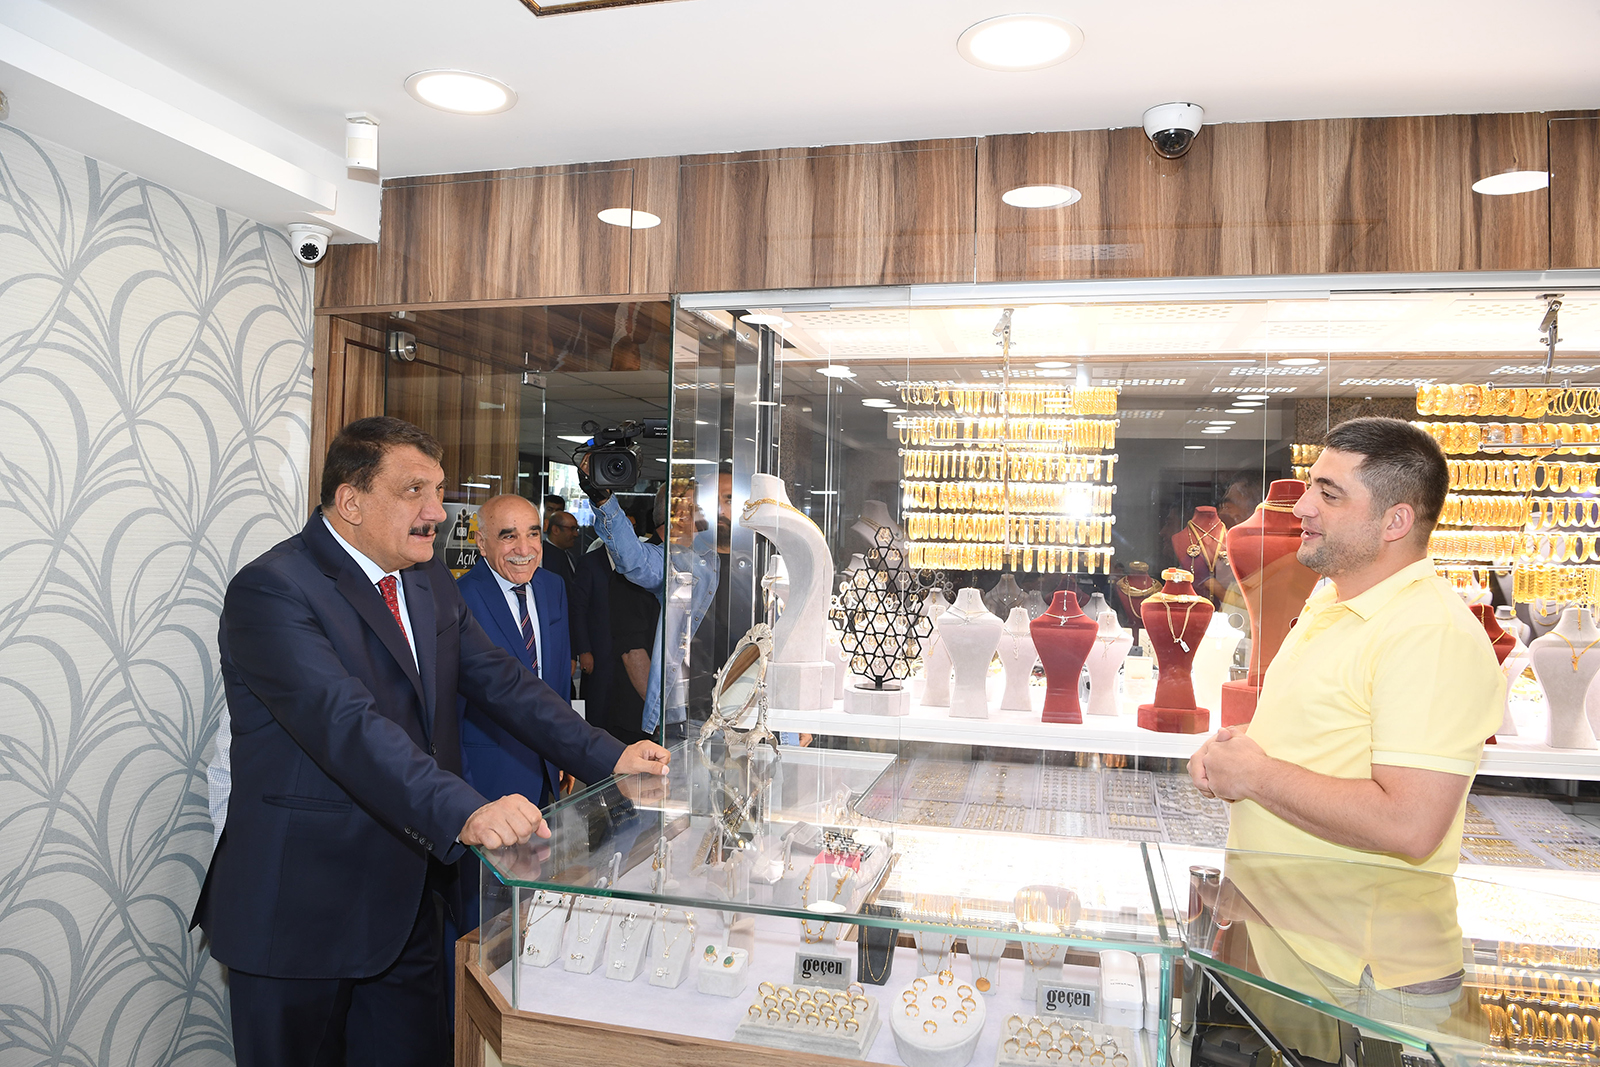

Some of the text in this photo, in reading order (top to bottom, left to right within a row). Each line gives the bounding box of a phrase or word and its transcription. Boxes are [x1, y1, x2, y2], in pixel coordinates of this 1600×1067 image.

[456, 550, 477, 569] Açık
[802, 959, 842, 979] geçen
[1046, 990, 1090, 1011] geçen
